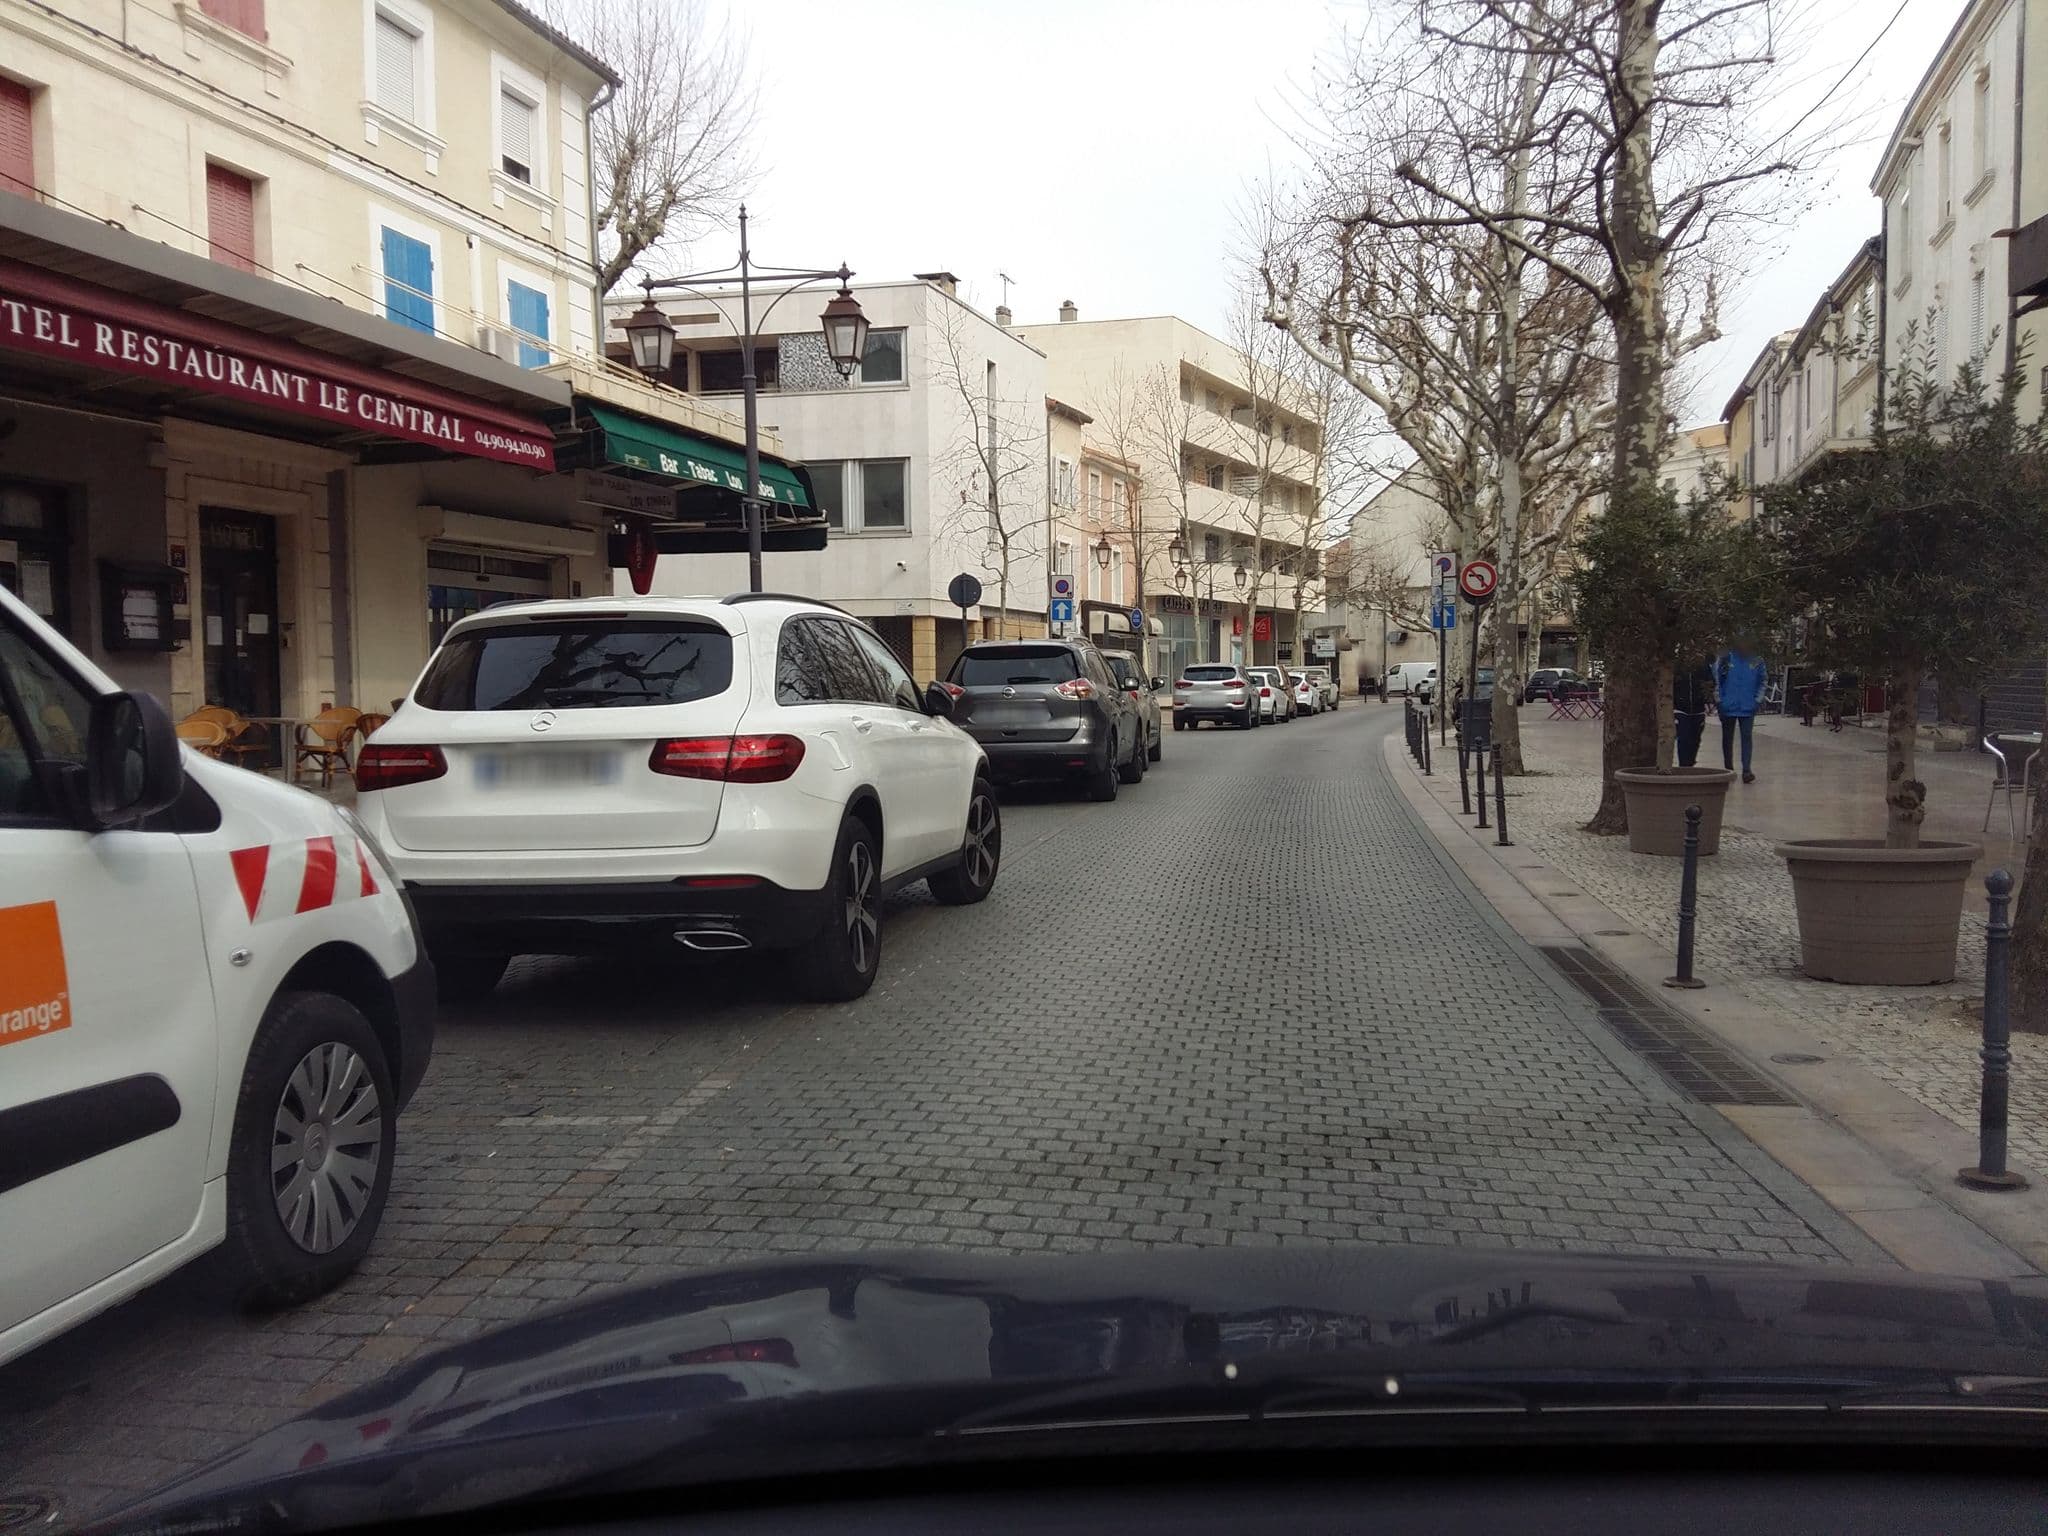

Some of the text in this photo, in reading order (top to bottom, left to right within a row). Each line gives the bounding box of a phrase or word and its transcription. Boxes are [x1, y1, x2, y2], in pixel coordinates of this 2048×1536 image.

[0, 299, 80, 348] TEL
[93, 322, 309, 403] RESTAURANT
[318, 381, 350, 414] LE
[357, 393, 466, 443] CENTRAL
[659, 453, 679, 475] Bar
[687, 460, 719, 483] Tabac
[0, 999, 63, 1035] range
